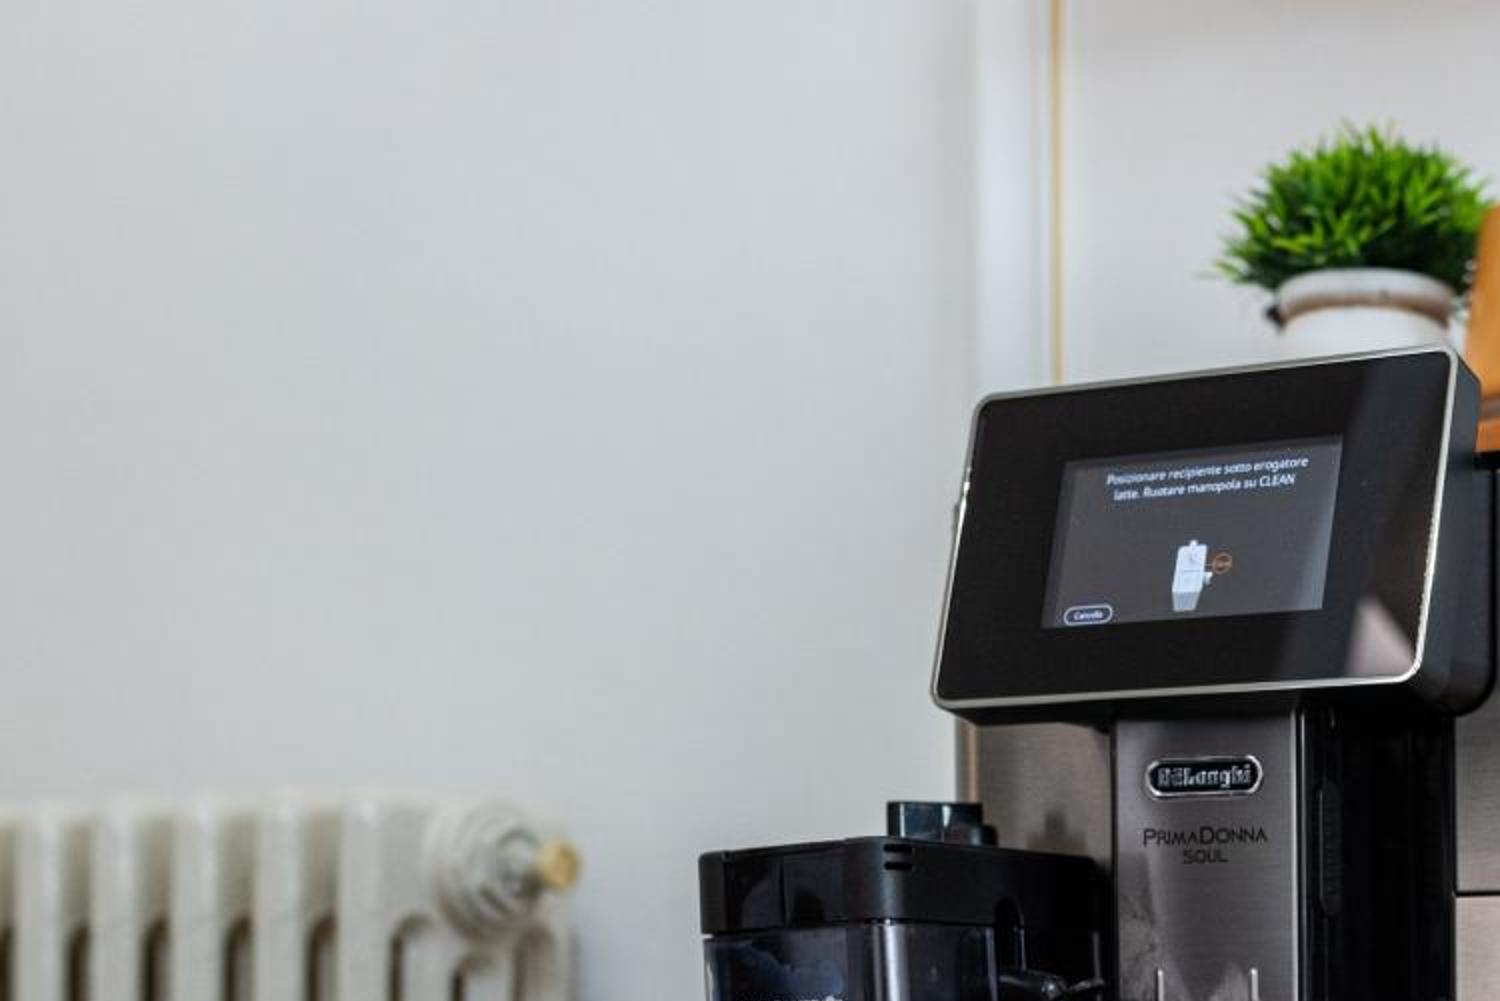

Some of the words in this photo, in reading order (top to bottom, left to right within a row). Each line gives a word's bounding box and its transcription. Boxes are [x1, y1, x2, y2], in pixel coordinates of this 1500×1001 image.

[1253, 457, 1309, 474] erogatore
[1187, 479, 1241, 494] manopola
[1244, 478, 1257, 489] su
[1259, 474, 1296, 487] CLEAN
[1183, 849, 1229, 865] SOUL
